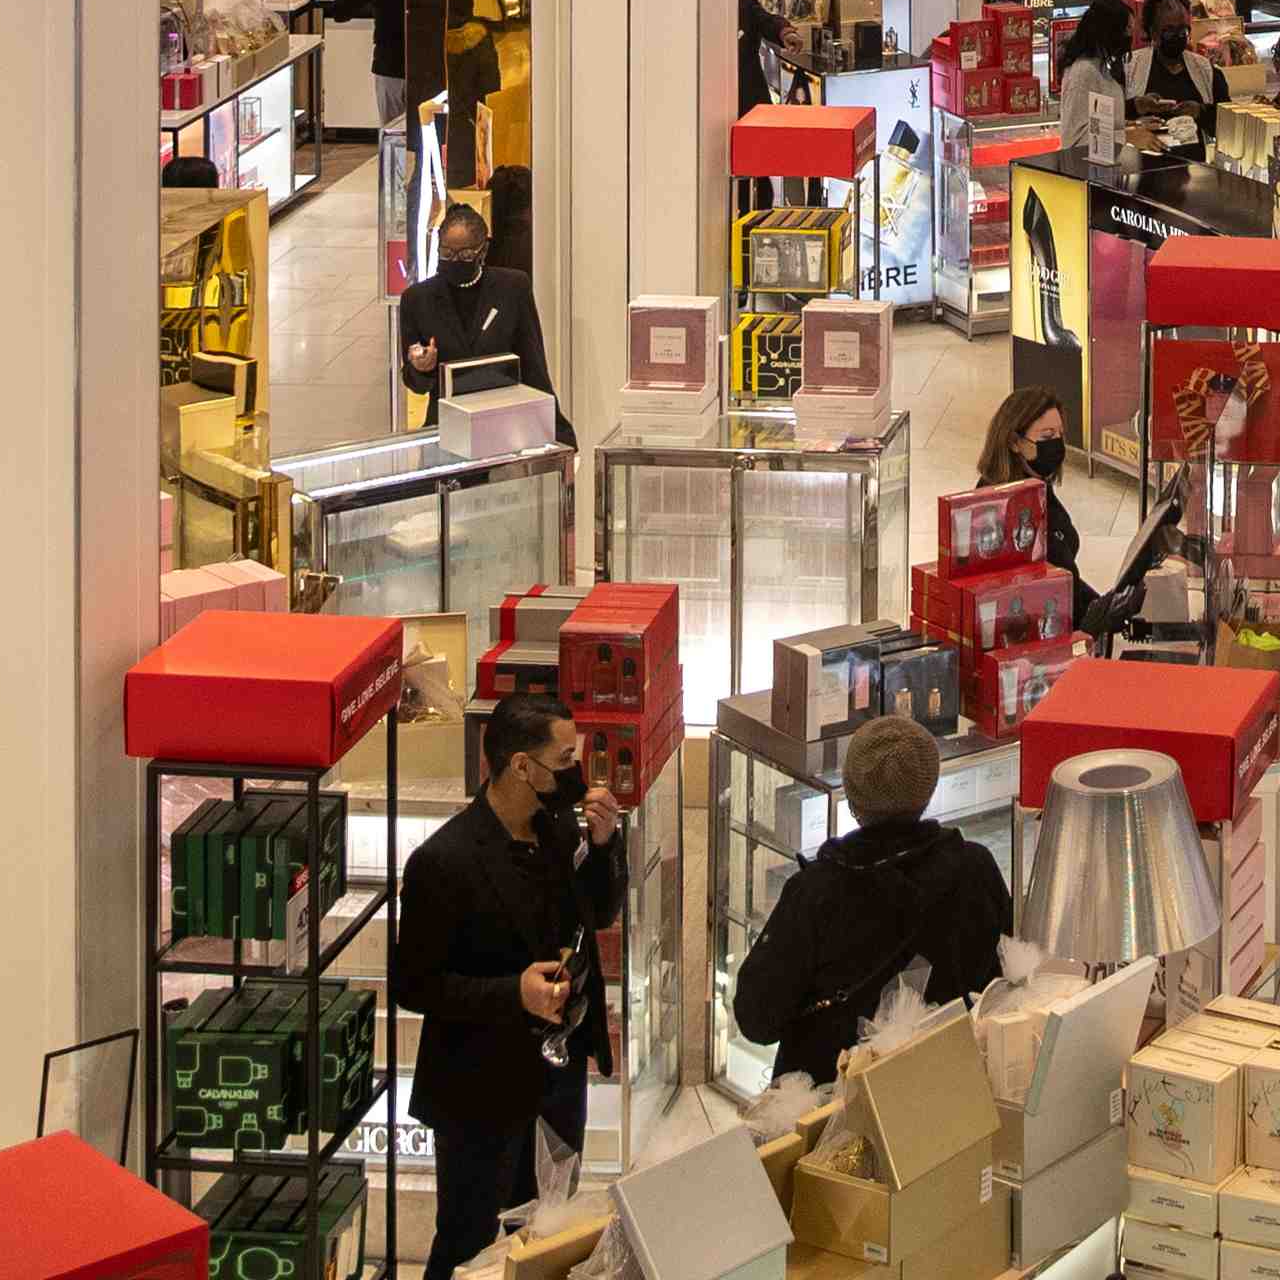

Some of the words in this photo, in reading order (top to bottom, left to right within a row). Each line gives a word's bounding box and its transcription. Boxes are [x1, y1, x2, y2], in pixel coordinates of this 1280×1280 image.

[1111, 206, 1168, 239] CAROLINA
[861, 263, 918, 293] IBRE
[345, 1124, 436, 1157] GIORGI
